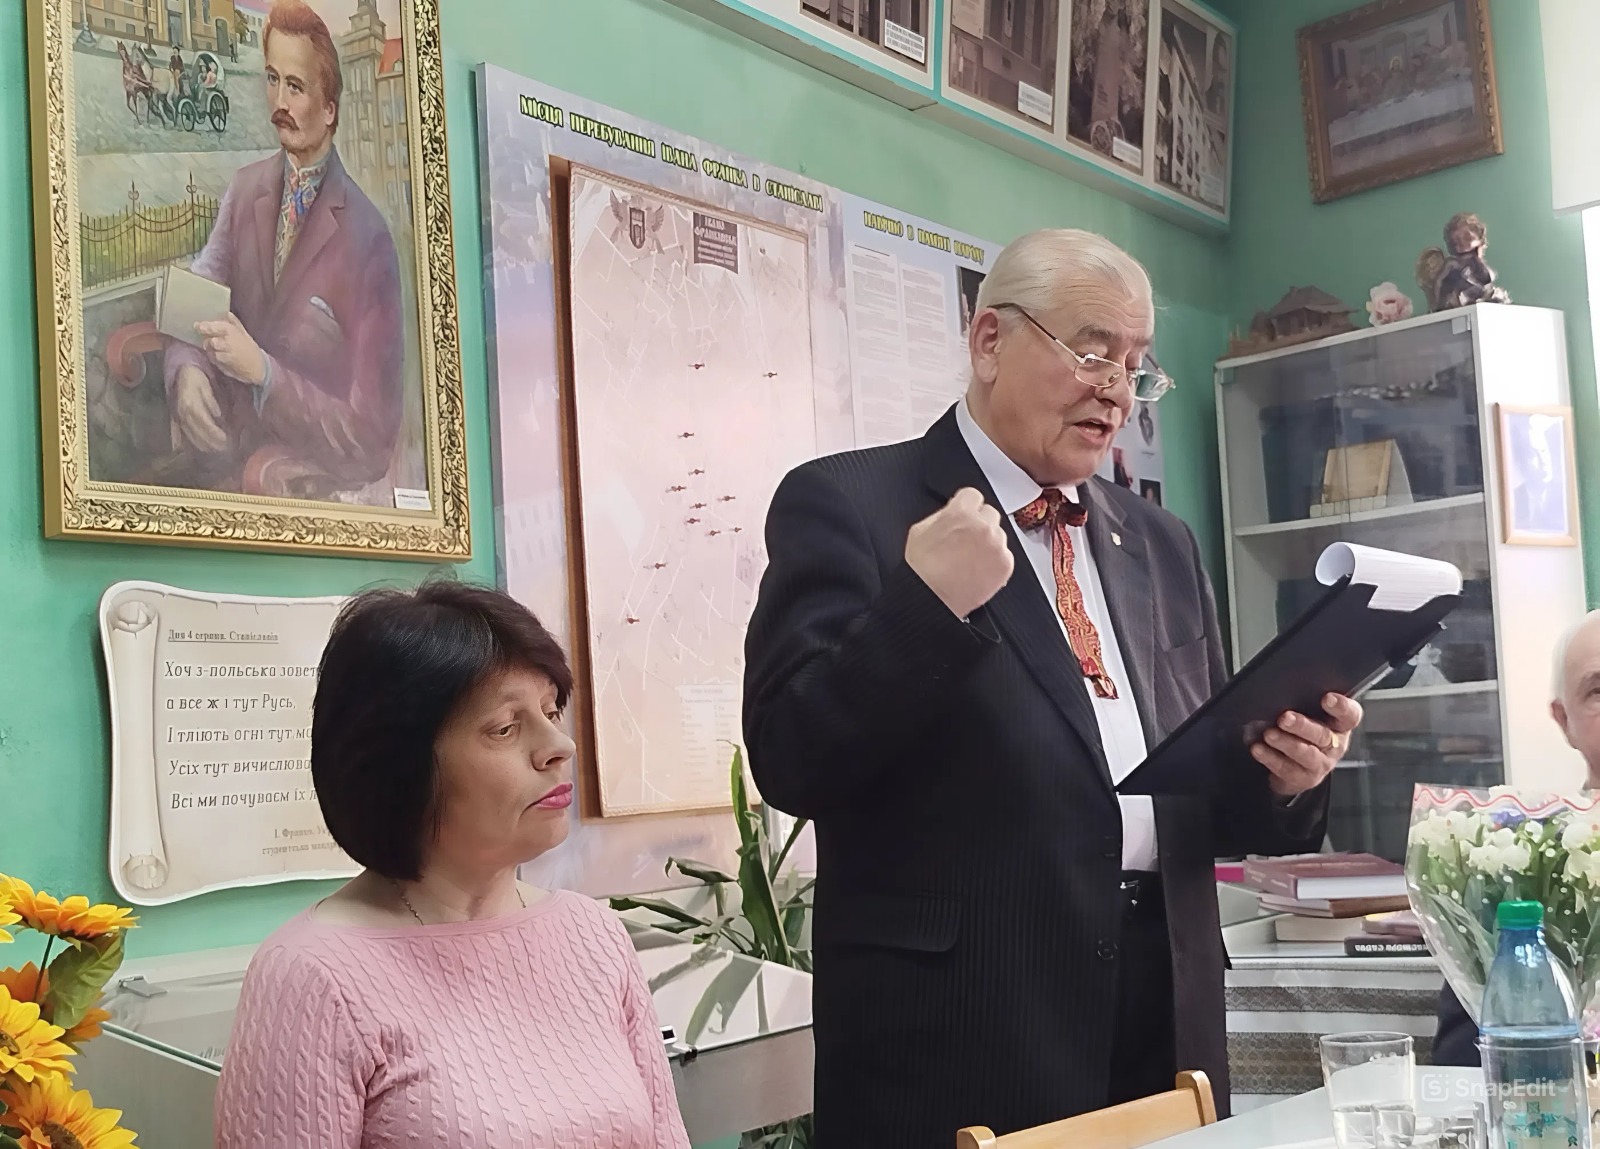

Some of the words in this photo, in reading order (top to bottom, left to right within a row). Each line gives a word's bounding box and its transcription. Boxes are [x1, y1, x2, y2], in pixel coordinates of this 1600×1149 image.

[520, 94, 563, 127] МІСЦЯ
[570, 112, 655, 158] ПЕРЕБУВАННЯ
[661, 142, 697, 172] ІВАНА
[702, 158, 748, 188] ФРАНКА
[752, 173, 760, 192] В
[187, 630, 193, 639] 4
[165, 661, 191, 677] Хоч
[196, 665, 276, 677] з-польська
[280, 666, 318, 677] зовет
[166, 698, 174, 710] а
[179, 698, 203, 710] все
[207, 698, 220, 710] ж
[233, 698, 258, 713] тут
[262, 693, 296, 712] Русь,
[167, 727, 173, 743] І
[177, 728, 229, 742] тліють
[234, 726, 264, 741] огні
[169, 760, 199, 776] Усіх
[203, 763, 229, 778] тут
[233, 759, 311, 773] вичислюва
[171, 792, 193, 809] Всі
[197, 794, 217, 807] ми
[222, 791, 290, 808] почуваєм
[294, 787, 305, 801] їх
